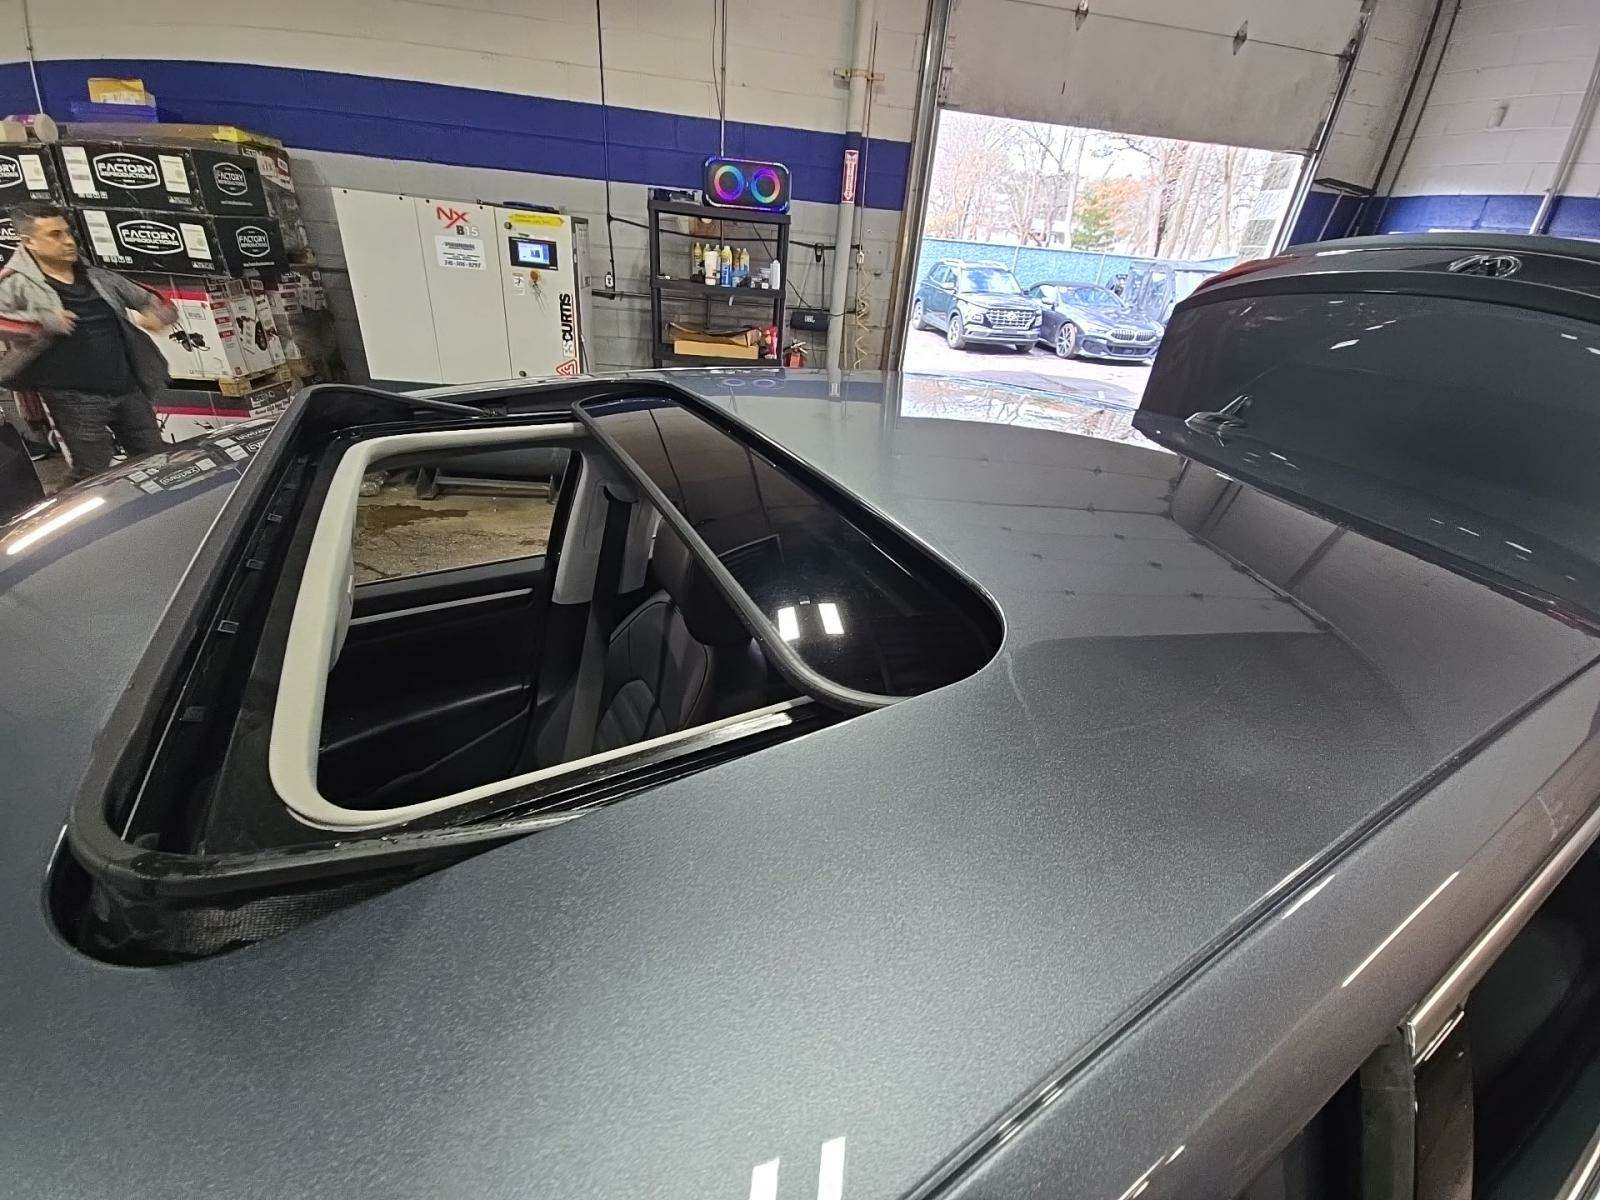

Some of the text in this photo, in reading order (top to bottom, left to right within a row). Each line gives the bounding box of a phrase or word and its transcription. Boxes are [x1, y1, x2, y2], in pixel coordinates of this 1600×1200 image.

[97, 162, 153, 174] FACTORY
[215, 171, 243, 182] FACTORY
[121, 229, 176, 241] FACTORY
[456, 225, 479, 237] B15
[239, 235, 266, 244] FACTORY
